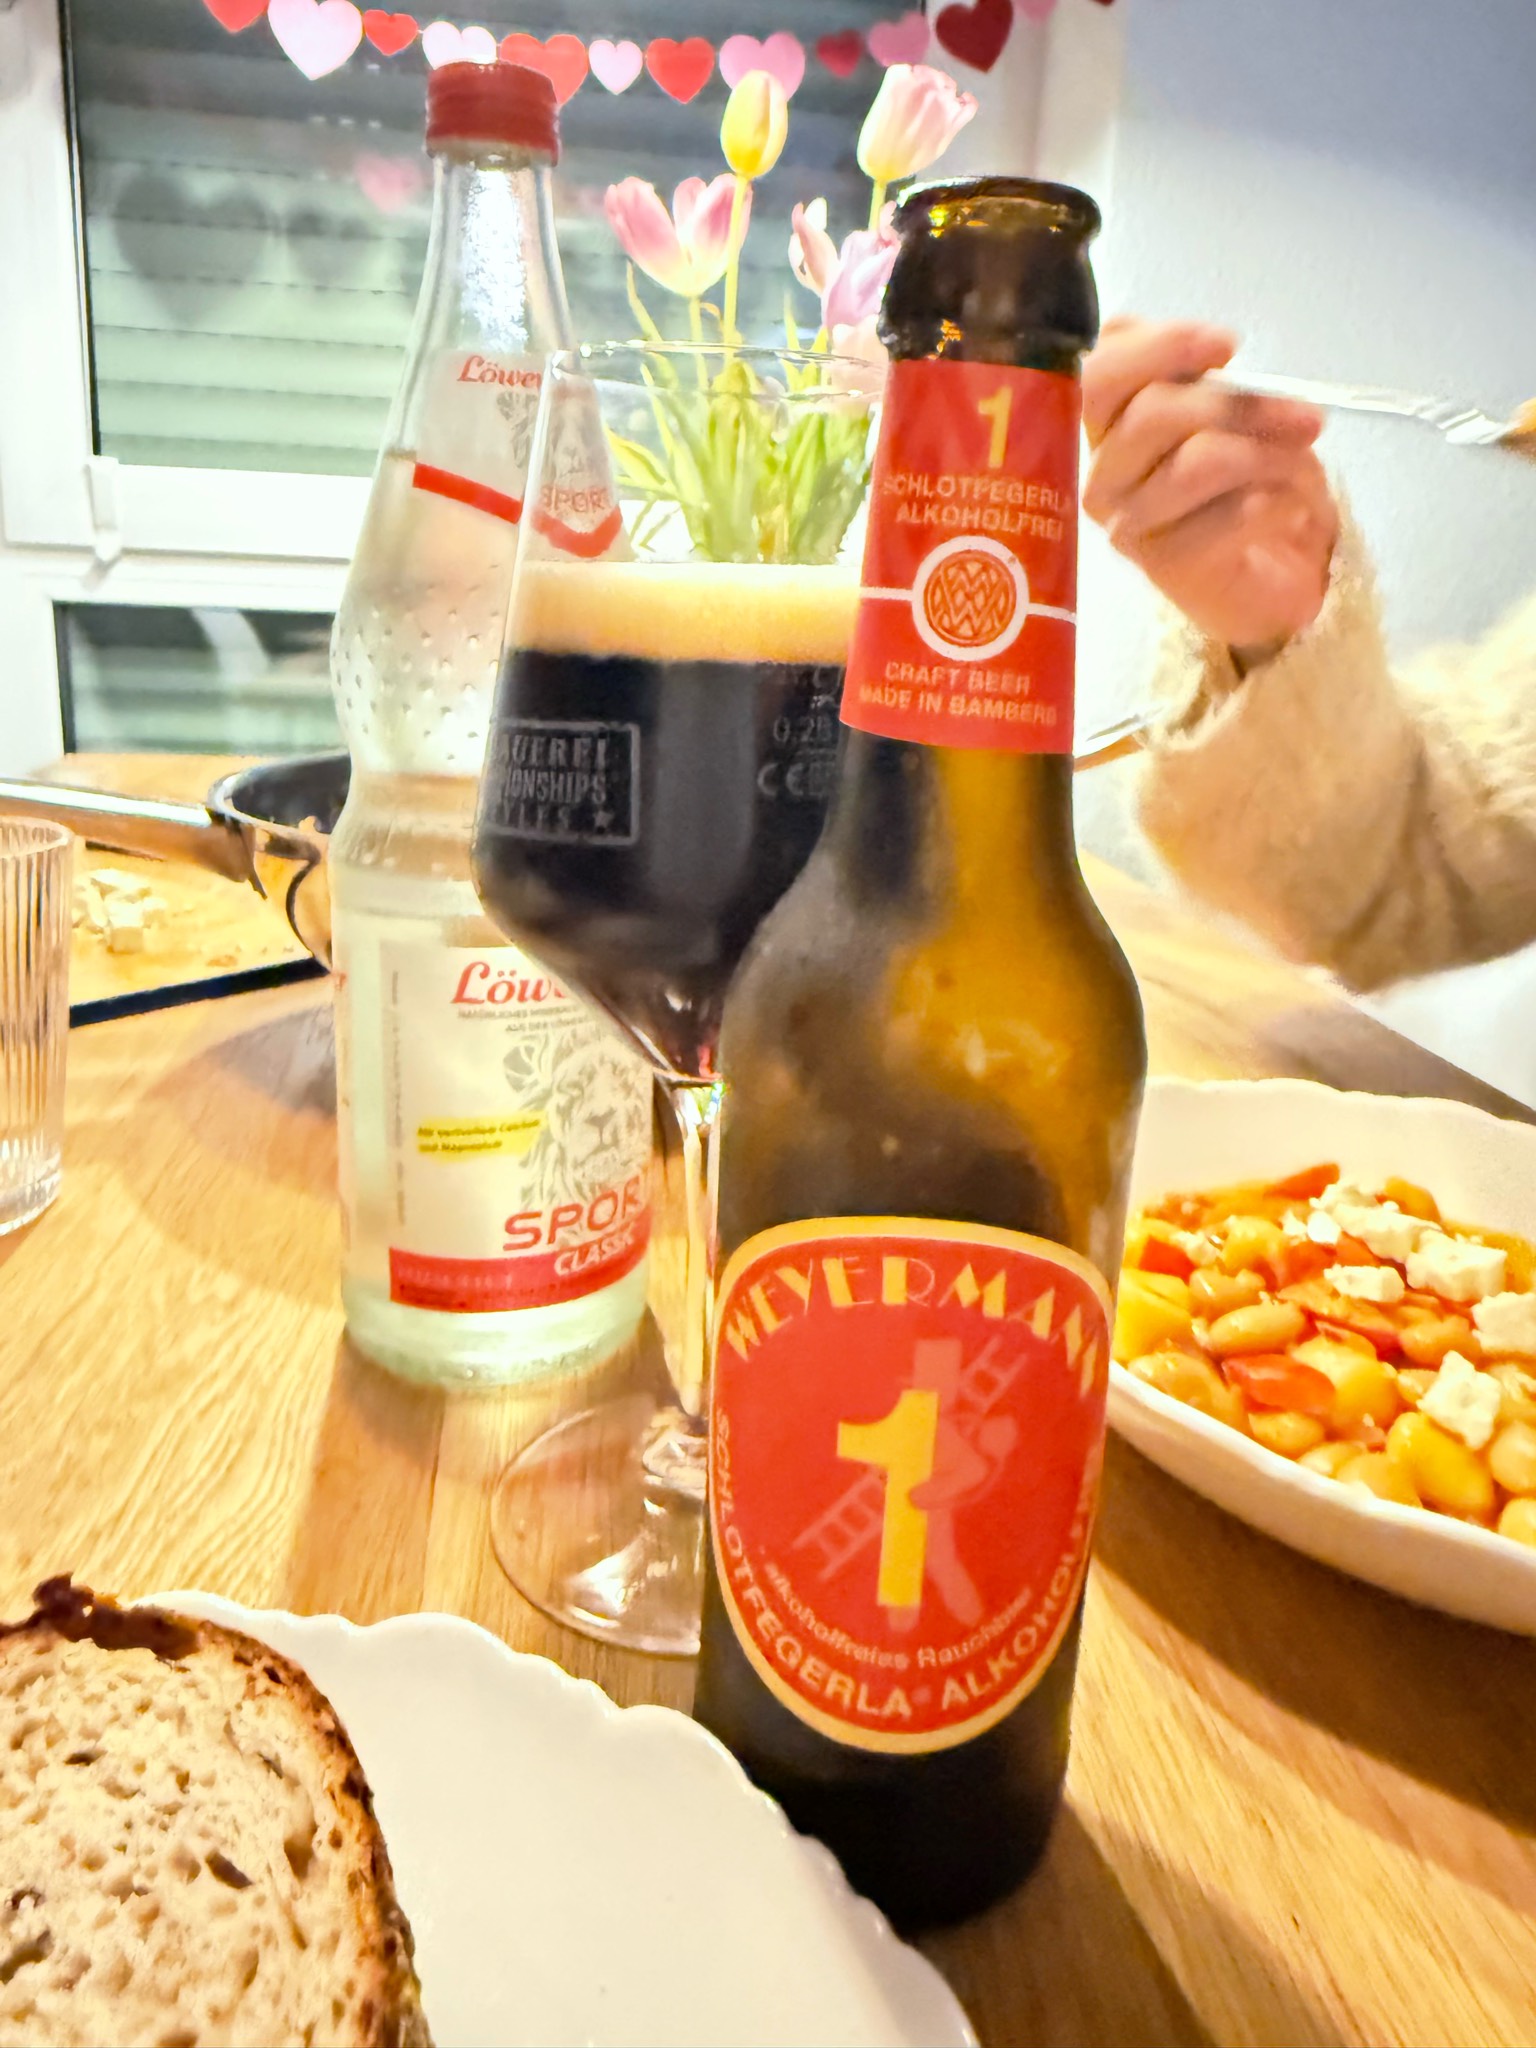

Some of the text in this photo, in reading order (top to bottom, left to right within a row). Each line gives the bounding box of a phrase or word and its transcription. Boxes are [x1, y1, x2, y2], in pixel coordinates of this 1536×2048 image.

[978, 385, 1013, 469] 1
[896, 502, 1064, 542] ALKOHOLFREI
[885, 661, 1031, 695] CRAFT BEER
[859, 684, 912, 709] MADE
[919, 690, 943, 713] IN
[837, 1390, 938, 1607] 1
